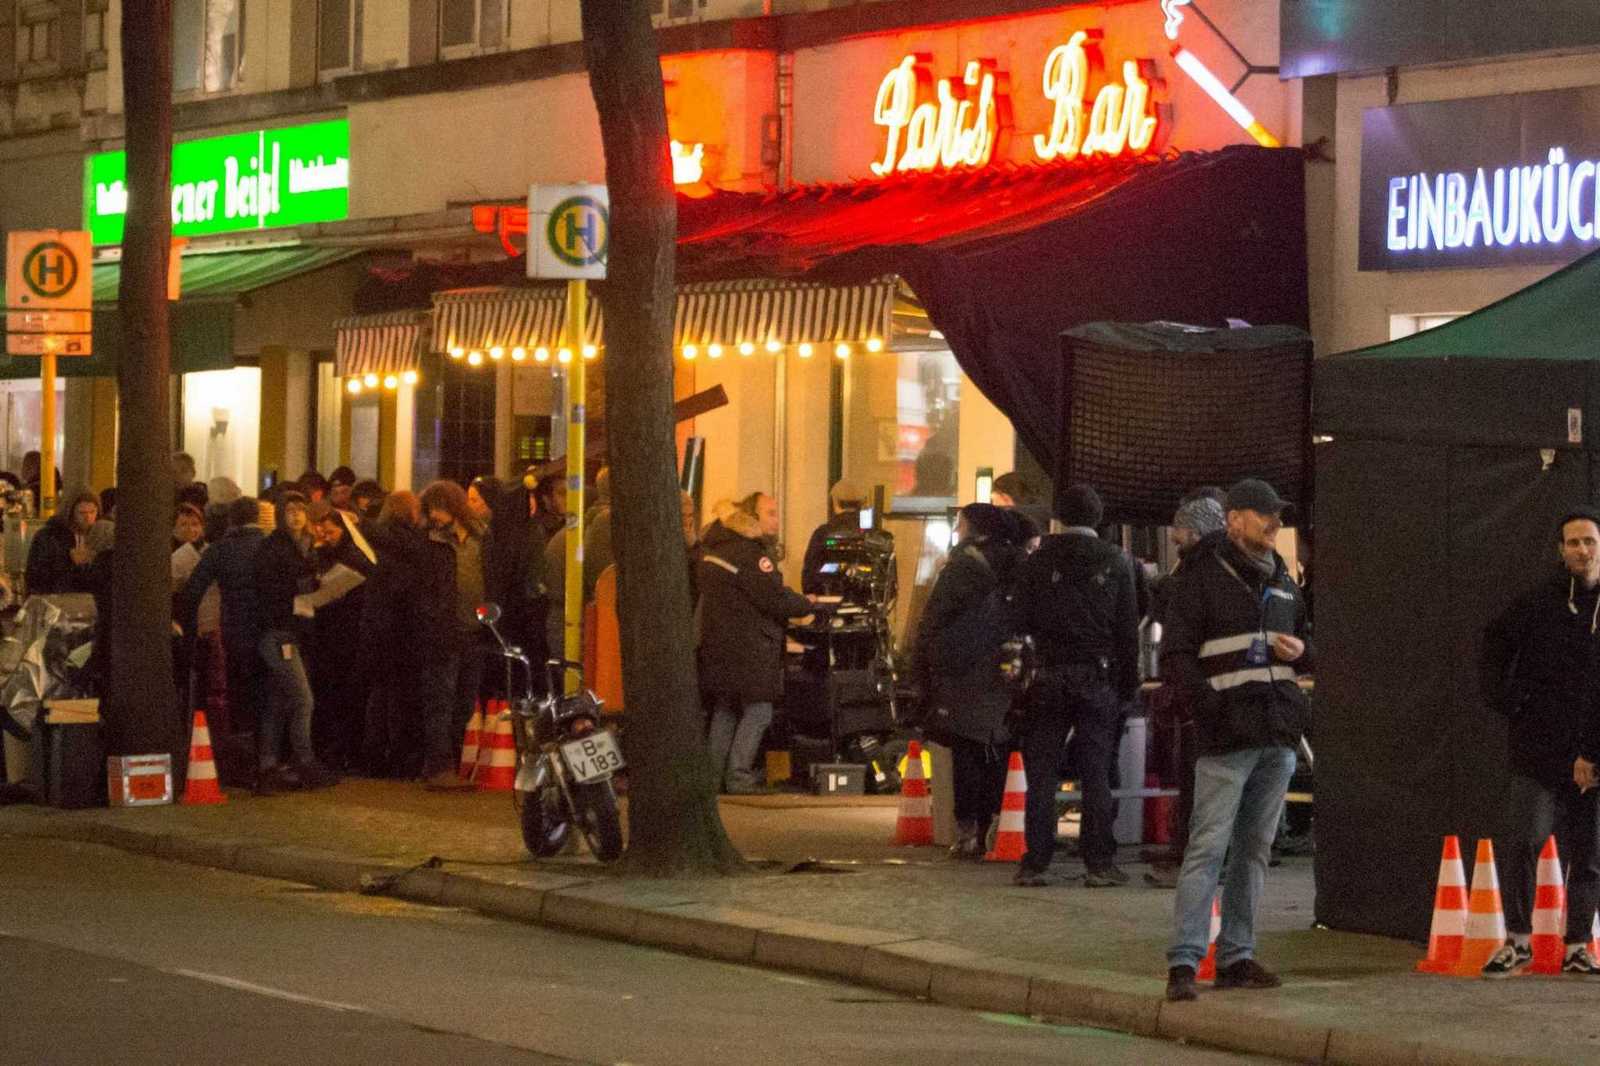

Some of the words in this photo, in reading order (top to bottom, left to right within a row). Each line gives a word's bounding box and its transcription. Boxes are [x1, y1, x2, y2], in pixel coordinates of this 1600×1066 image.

[870, 54, 994, 176] Paris
[1033, 30, 1157, 159] Bar
[171, 180, 218, 225] ener
[566, 213, 595, 250] H
[38, 255, 64, 285] H
[573, 761, 586, 778] V
[590, 751, 620, 773] 183
[581, 740, 597, 757] B
